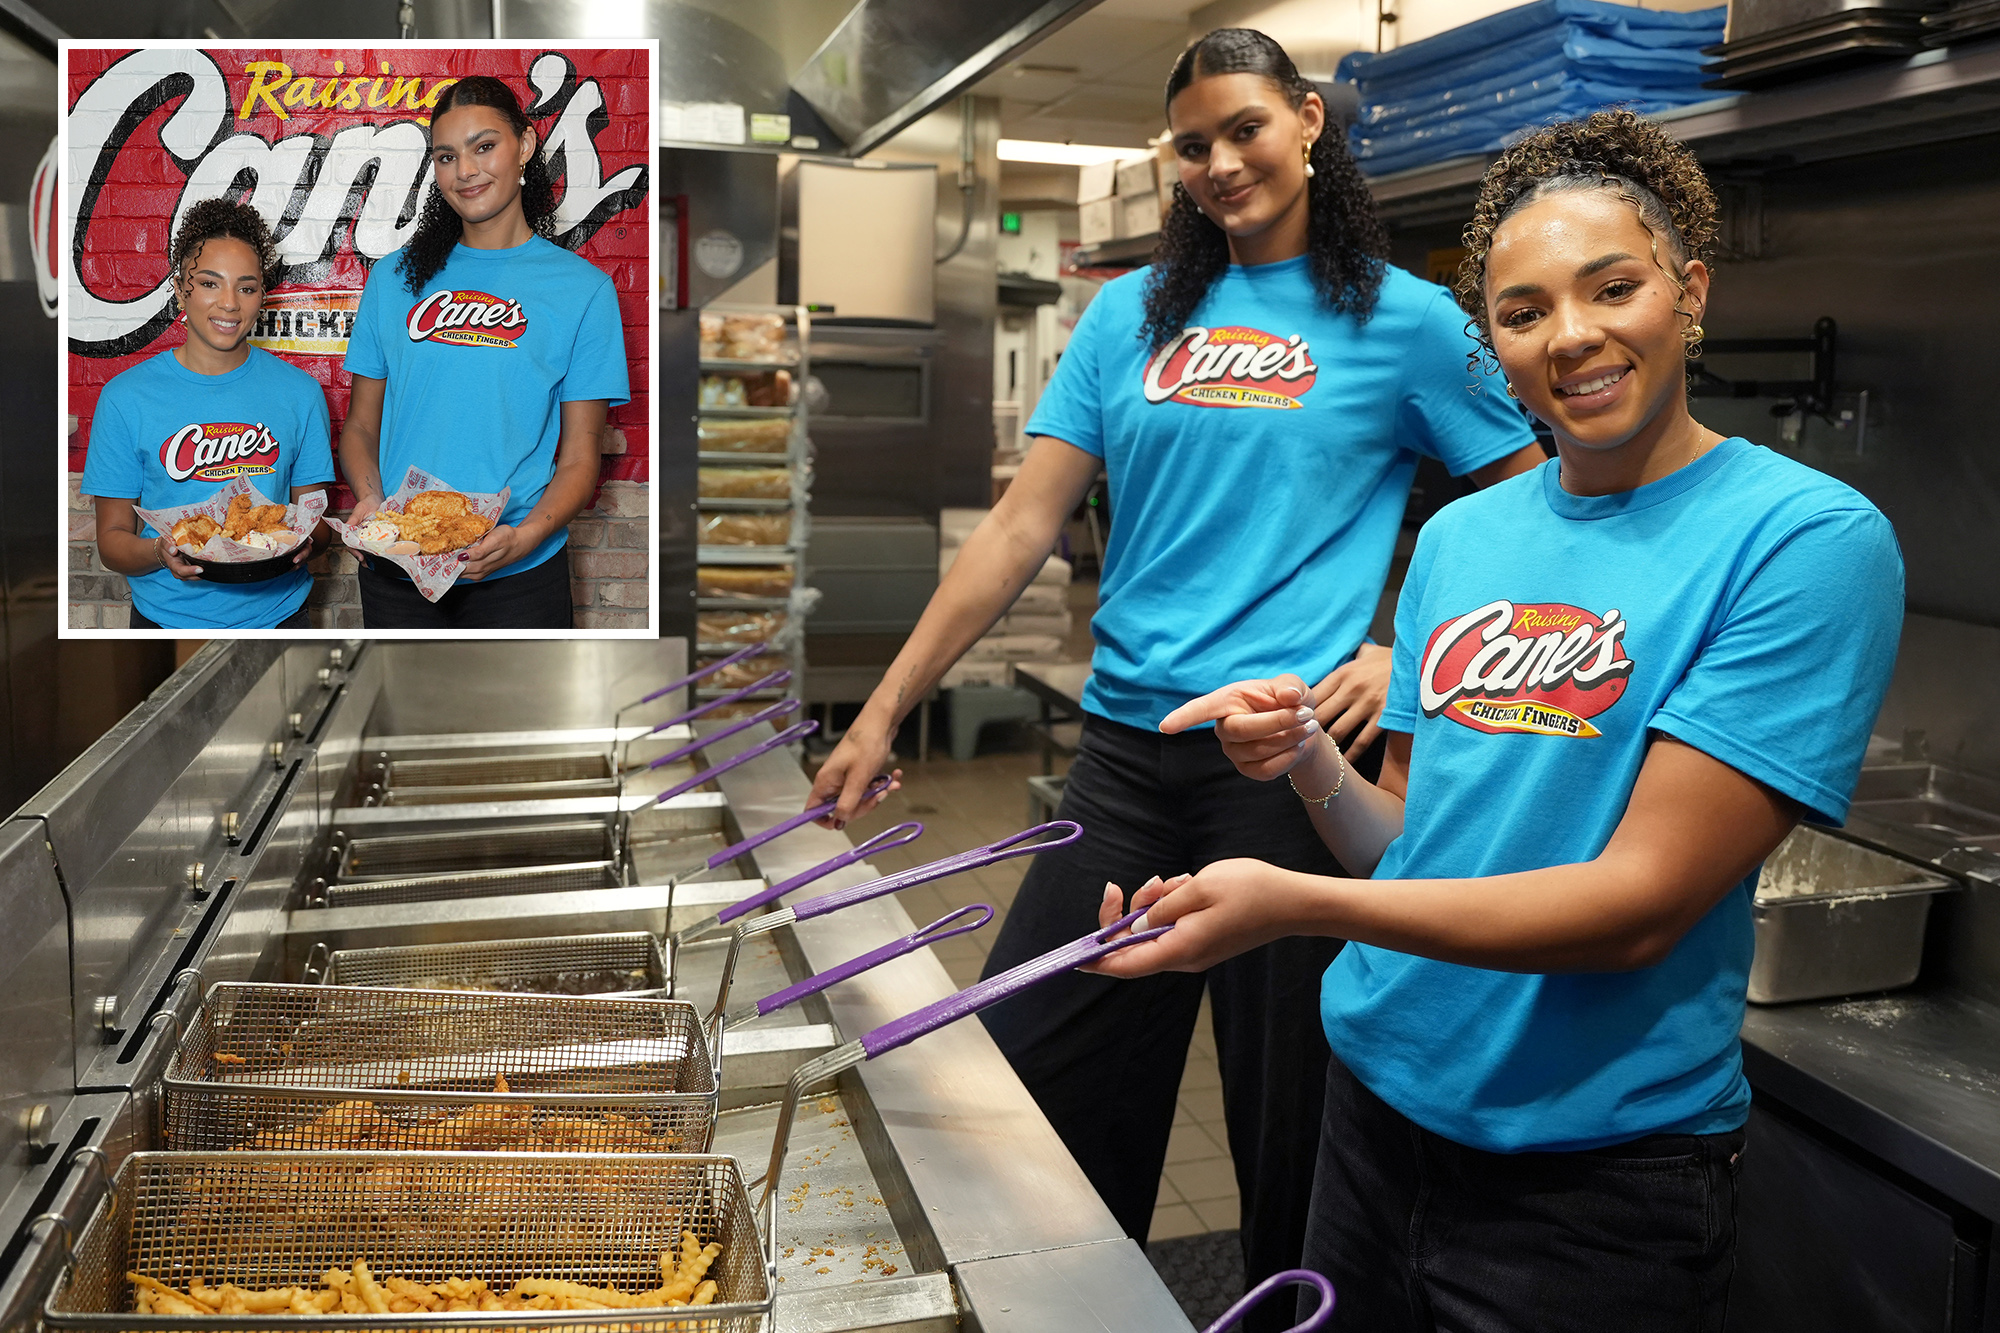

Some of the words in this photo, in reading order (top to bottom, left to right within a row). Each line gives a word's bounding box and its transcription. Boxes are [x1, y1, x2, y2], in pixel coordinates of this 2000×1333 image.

[68, 49, 648, 345] Can's
[454, 292, 495, 305] Raising
[408, 290, 528, 343] Cane's
[441, 331, 474, 342] CHICKEN
[476, 335, 509, 347] FINGERS
[1209, 328, 1270, 346] Raising
[1143, 326, 1318, 404] Cane's
[1191, 388, 1237, 400] CHICKEN
[1241, 393, 1289, 407] FINGERS
[205, 424, 244, 437] Raising
[165, 422, 279, 482] Cane's
[204, 469, 235, 477] CHICKEN
[1513, 608, 1581, 633] Raising
[1420, 599, 1635, 719] Cane's
[1470, 702, 1521, 721] CHICKEN
[1521, 706, 1579, 734] FINGERS
